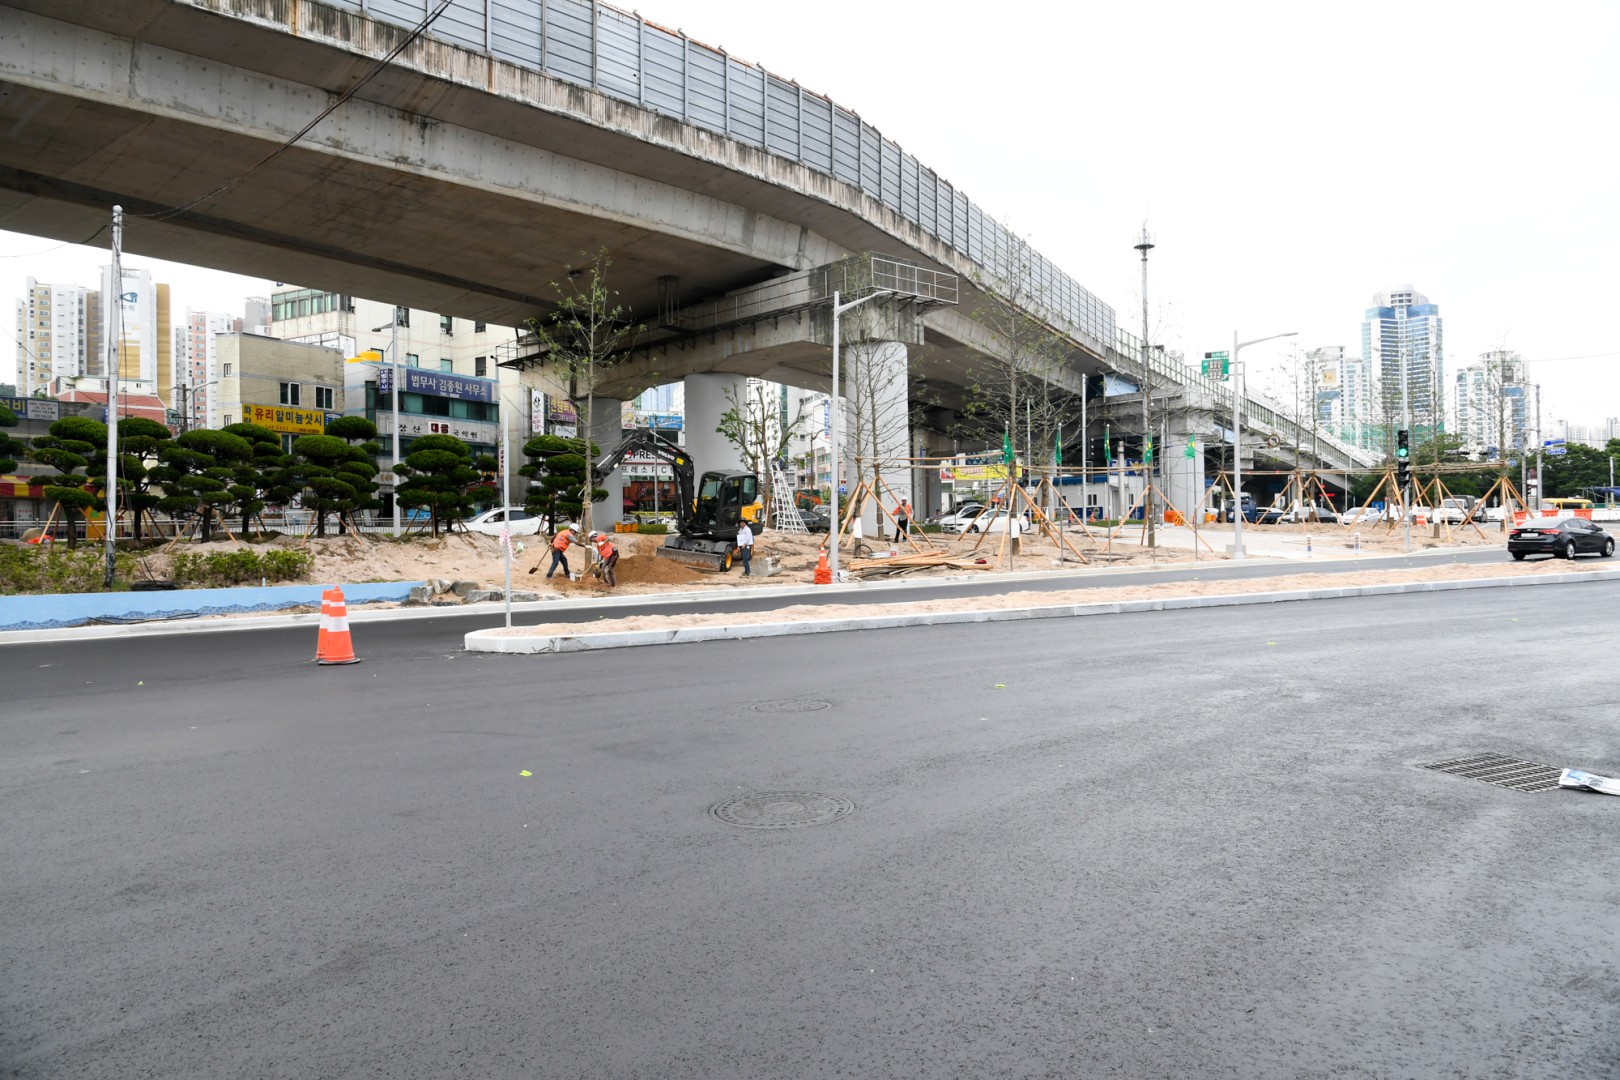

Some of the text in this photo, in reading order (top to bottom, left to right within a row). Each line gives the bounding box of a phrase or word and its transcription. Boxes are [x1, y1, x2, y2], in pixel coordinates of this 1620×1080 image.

[411, 375, 437, 390] 법무사
[439, 379, 463, 394] 김종원
[465, 383, 488, 396] 사무소
[255, 408, 274, 422] 유리
[657, 449, 675, 461] VOLVO
